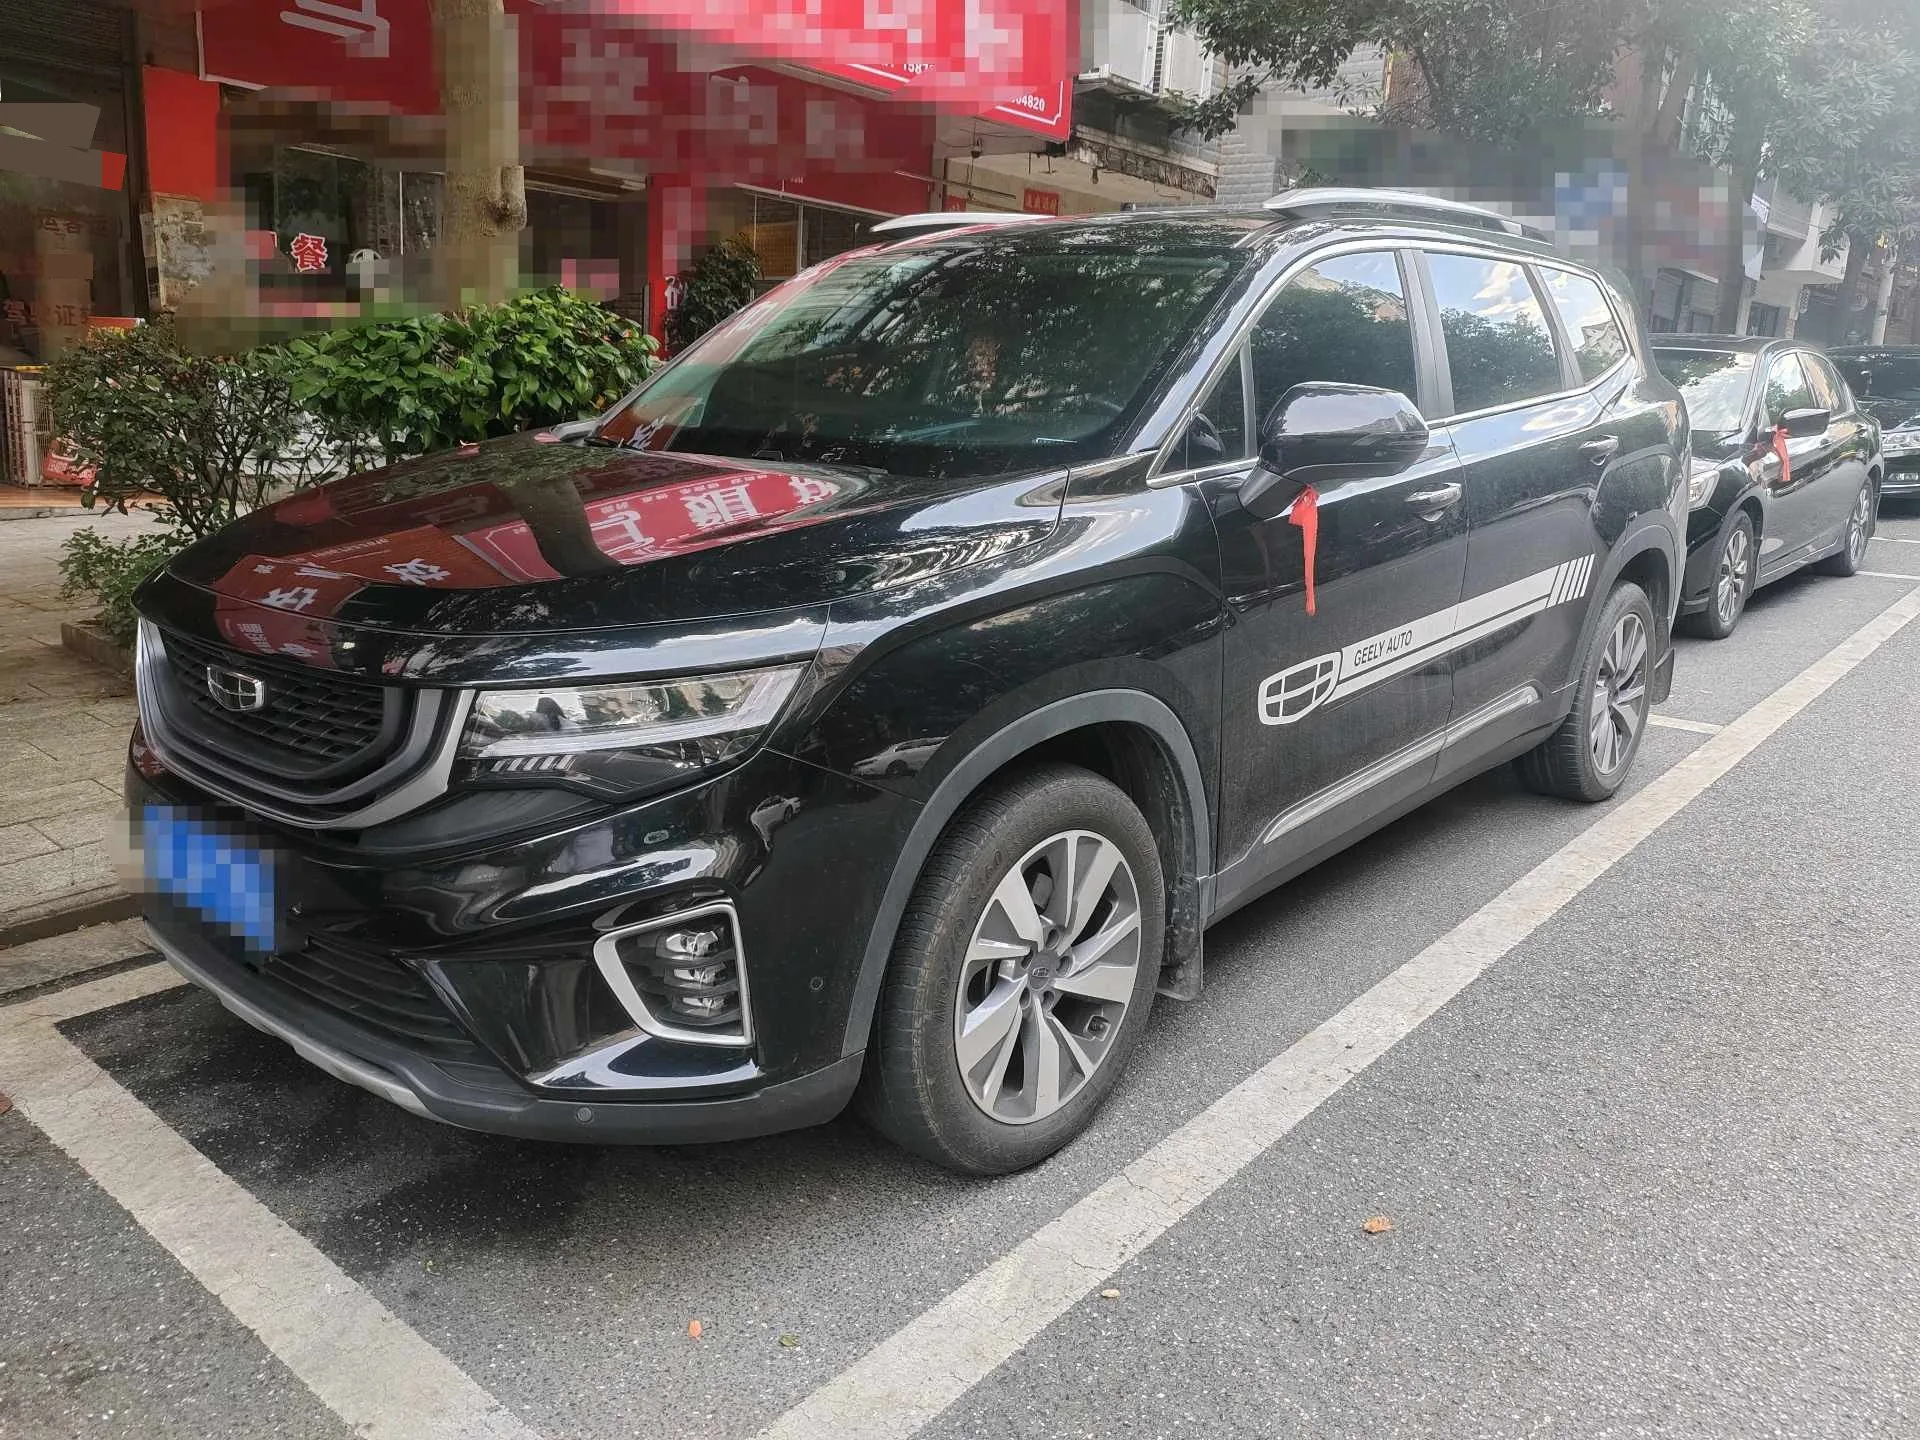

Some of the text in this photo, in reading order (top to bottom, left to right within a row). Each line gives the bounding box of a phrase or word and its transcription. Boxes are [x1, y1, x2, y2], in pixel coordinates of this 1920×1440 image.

[291, 233, 328, 272] 餐
[1354, 630, 1412, 666] GEELY AUTO
